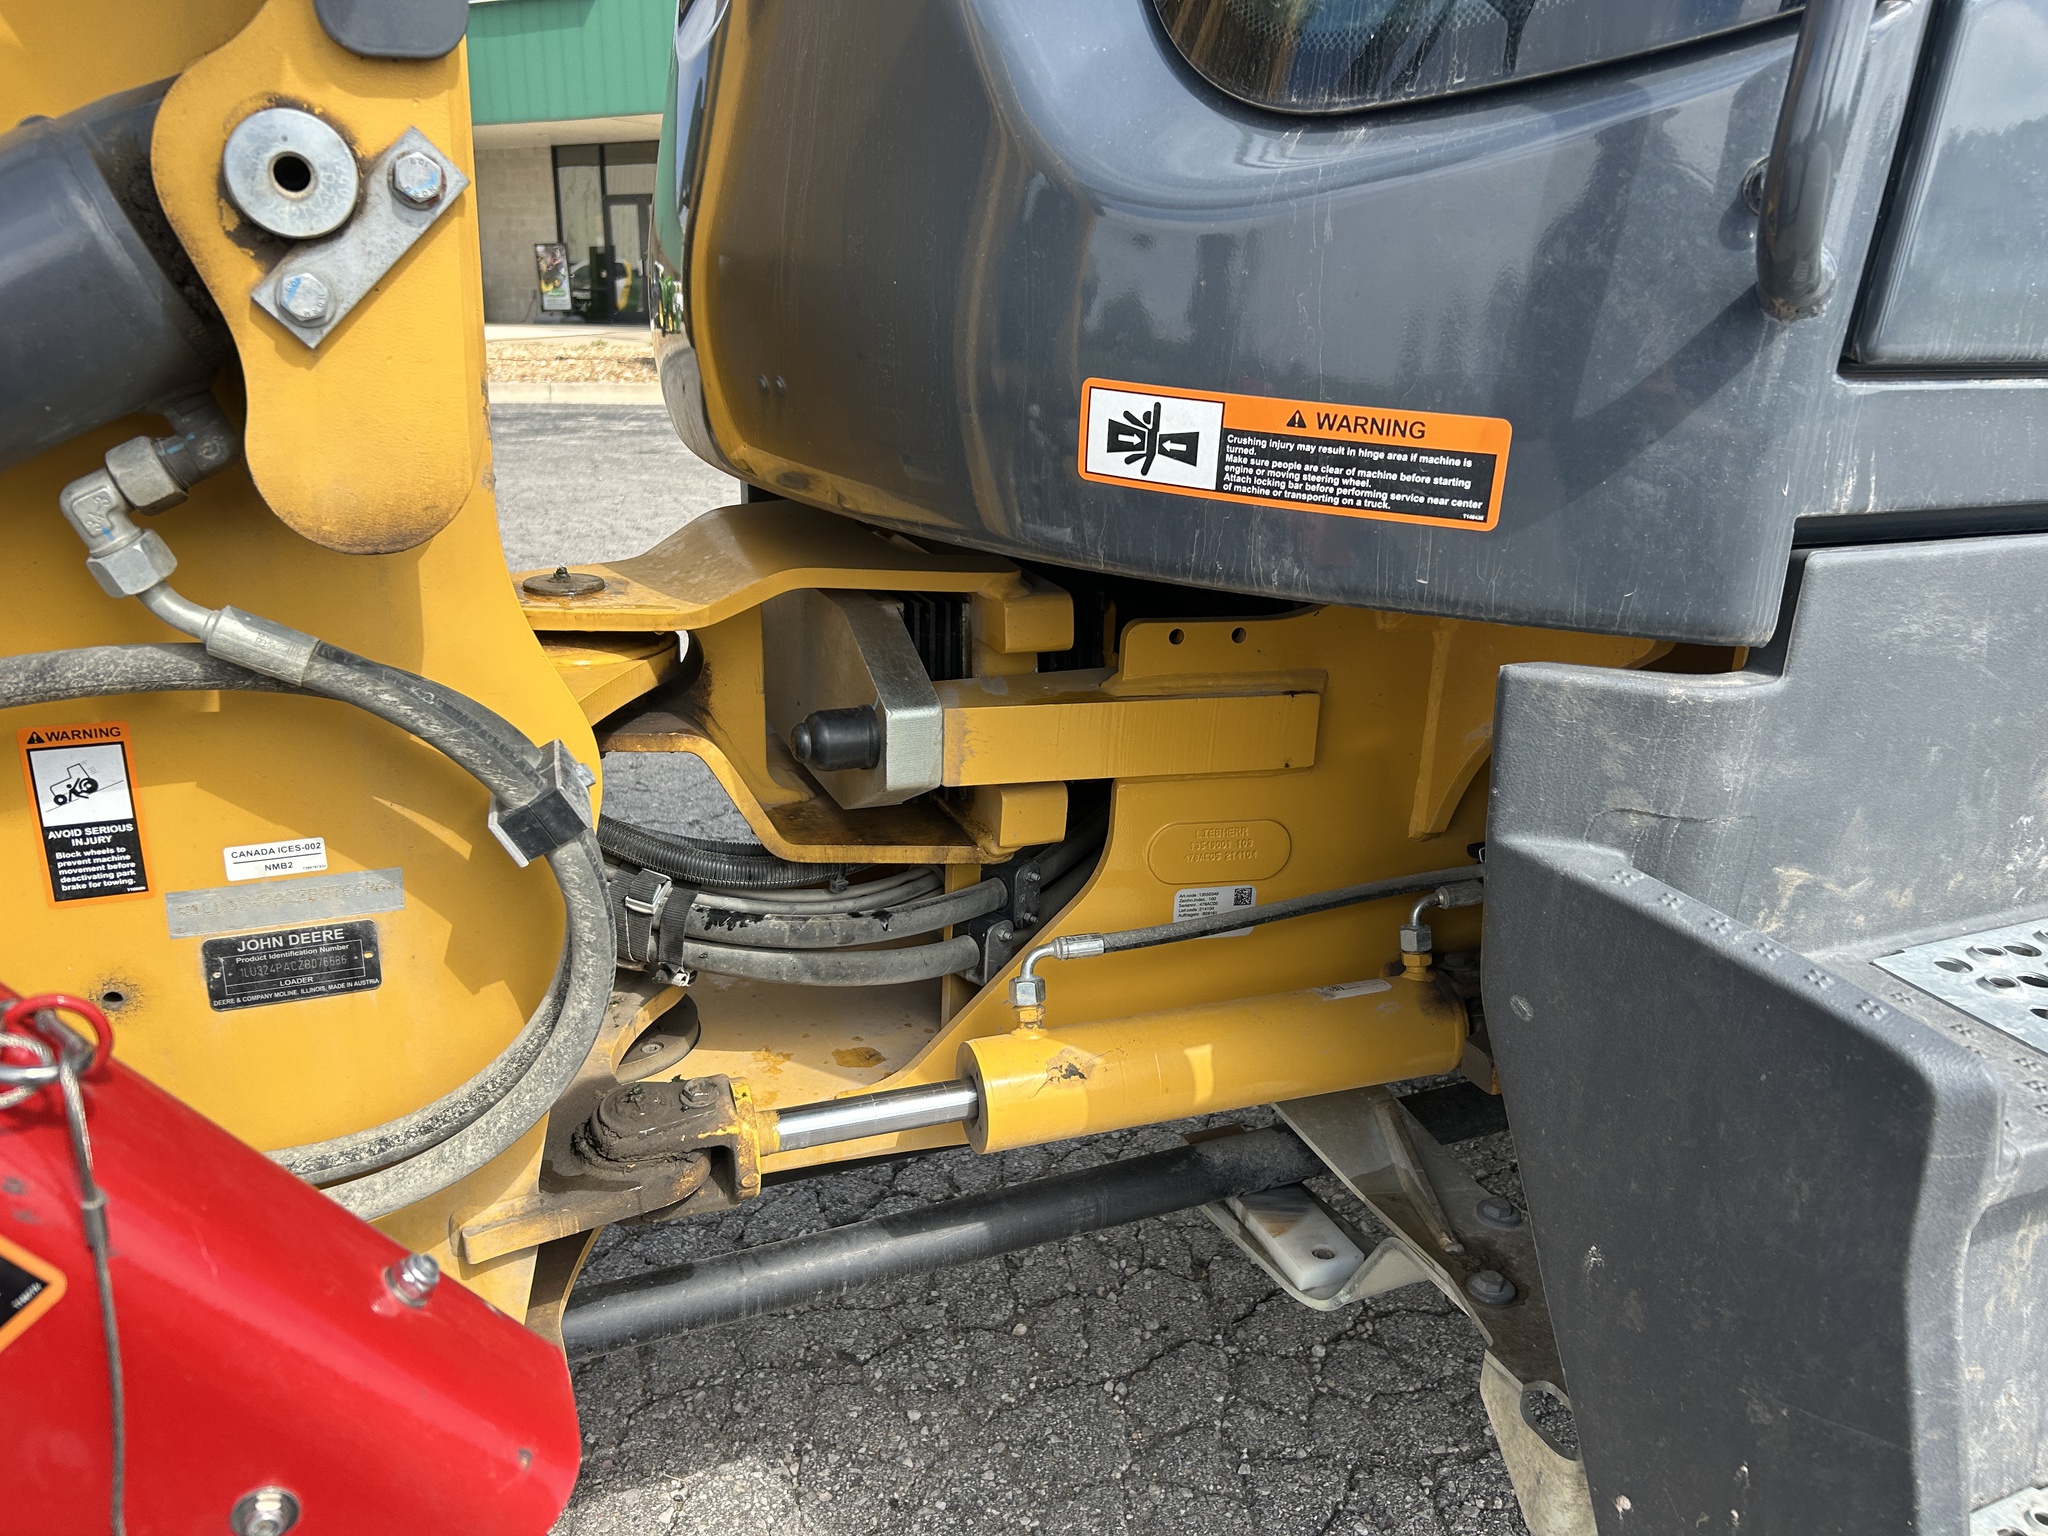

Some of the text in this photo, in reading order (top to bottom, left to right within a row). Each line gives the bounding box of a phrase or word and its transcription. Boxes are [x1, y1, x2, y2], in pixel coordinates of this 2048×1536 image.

[1316, 413, 1425, 439] WARNING
[1226, 445, 1256, 455] turned.
[1227, 434, 1472, 467] Crushing injury may result in hinge area if machine is
[1225, 454, 1248, 464] Make
[1250, 458, 1269, 466] sure
[1272, 459, 1302, 472] people
[1321, 464, 1343, 474] clear
[1346, 467, 1355, 475] of
[1357, 468, 1397, 480] machine
[1400, 472, 1430, 484] before
[1433, 475, 1471, 490] starting
[1225, 463, 1253, 475] engine
[1267, 468, 1299, 481] moving
[1302, 472, 1339, 486] steering
[1341, 476, 1371, 487] wheel.
[1223, 482, 1231, 490] of
[1234, 484, 1269, 495] machine
[1284, 489, 1339, 505] transporting
[1364, 498, 1391, 509] truck.
[1224, 473, 1482, 509] Attach locking bar before performing service near center
[45, 726, 121, 742] WARNING
[48, 823, 133, 840] AVOID SERIOUS
[1195, 827, 1248, 838] LIEBHERR
[72, 835, 112, 846] INJURY
[56, 850, 81, 859] Block
[83, 847, 114, 856] wheels
[231, 842, 321, 858] CANADA ICES-002
[57, 853, 130, 868] prevent machine
[58, 860, 135, 875] movement before
[264, 862, 293, 871] NMB2
[60, 869, 136, 883] deactivating park
[61, 882, 86, 891] brake
[103, 877, 136, 888] towing.
[237, 928, 344, 952] JOHN DEERE
[236, 944, 349, 963] Product Identification Number
[279, 976, 313, 986] LOADER
[213, 998, 236, 1006] DEERE
[242, 993, 273, 1002] COMPANY
[274, 990, 298, 998] MOLINE,
[301, 986, 327, 994] ILLINOIS,
[353, 978, 379, 986] AUSTRIA
